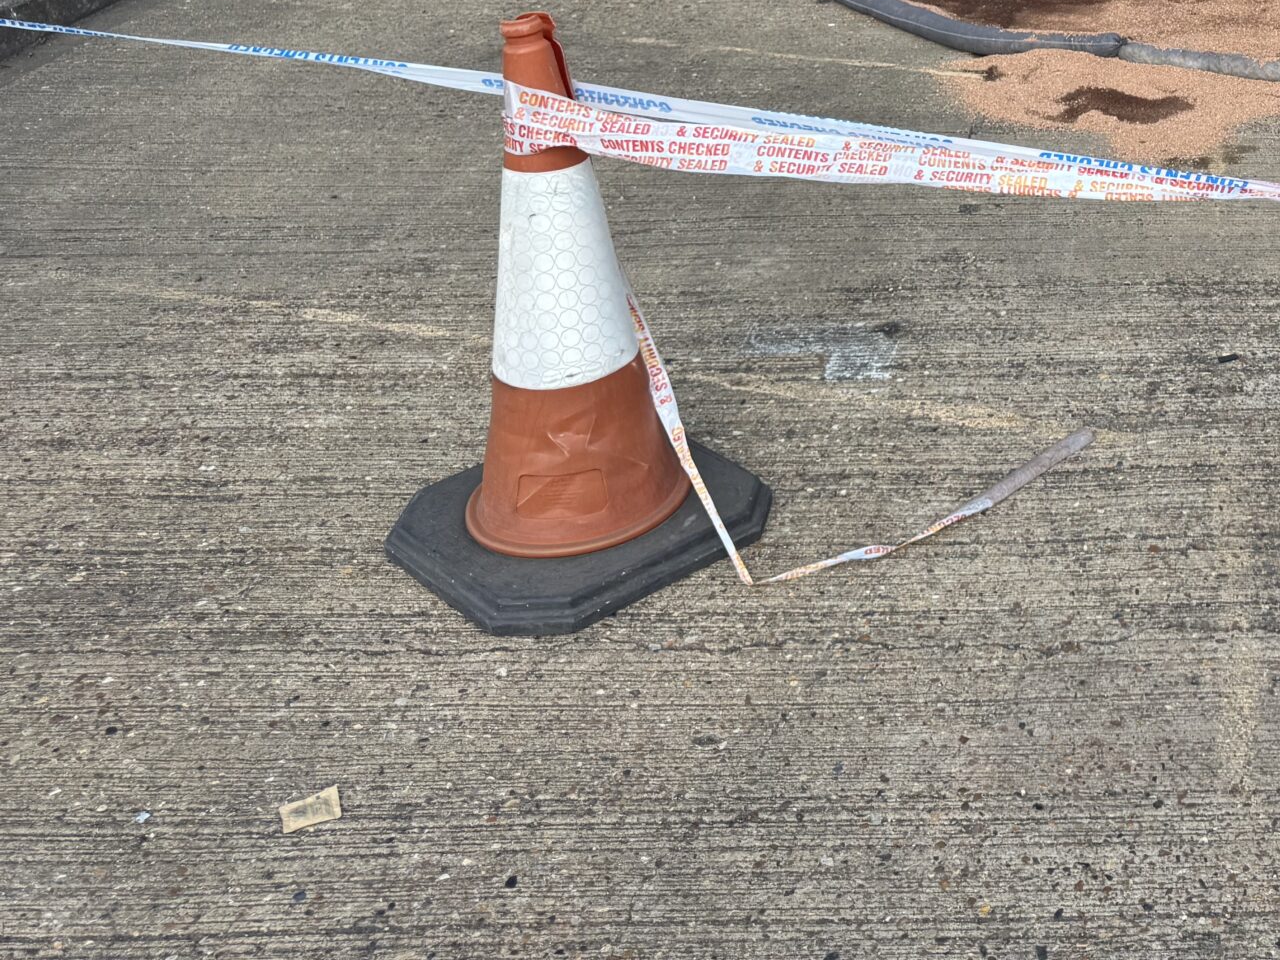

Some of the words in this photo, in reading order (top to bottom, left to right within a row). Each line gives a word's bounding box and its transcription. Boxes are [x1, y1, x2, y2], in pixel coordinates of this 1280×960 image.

[519, 91, 593, 119] CONTENTS
[514, 106, 526, 120] &
[530, 111, 596, 133] SECURITY
[601, 121, 651, 135] SEALED
[676, 125, 687, 137] &
[693, 127, 759, 144] SECURITY
[763, 135, 817, 148] SEALED
[842, 140, 852, 151] &
[600, 138, 665, 153] CONTENTS
[668, 141, 731, 156] CHECKED
[756, 145, 830, 163] CONTENTS
[677, 158, 728, 171] SEALED
[753, 160, 764, 172] &
[769, 161, 833, 176] SECURITY
[838, 162, 888, 176] SEALED
[918, 155, 986, 171] CONTENTS
[914, 169, 924, 180] &
[929, 170, 993, 184] SECURITY
[998, 174, 1048, 190] SEALED
[1074, 179, 1084, 192] &
